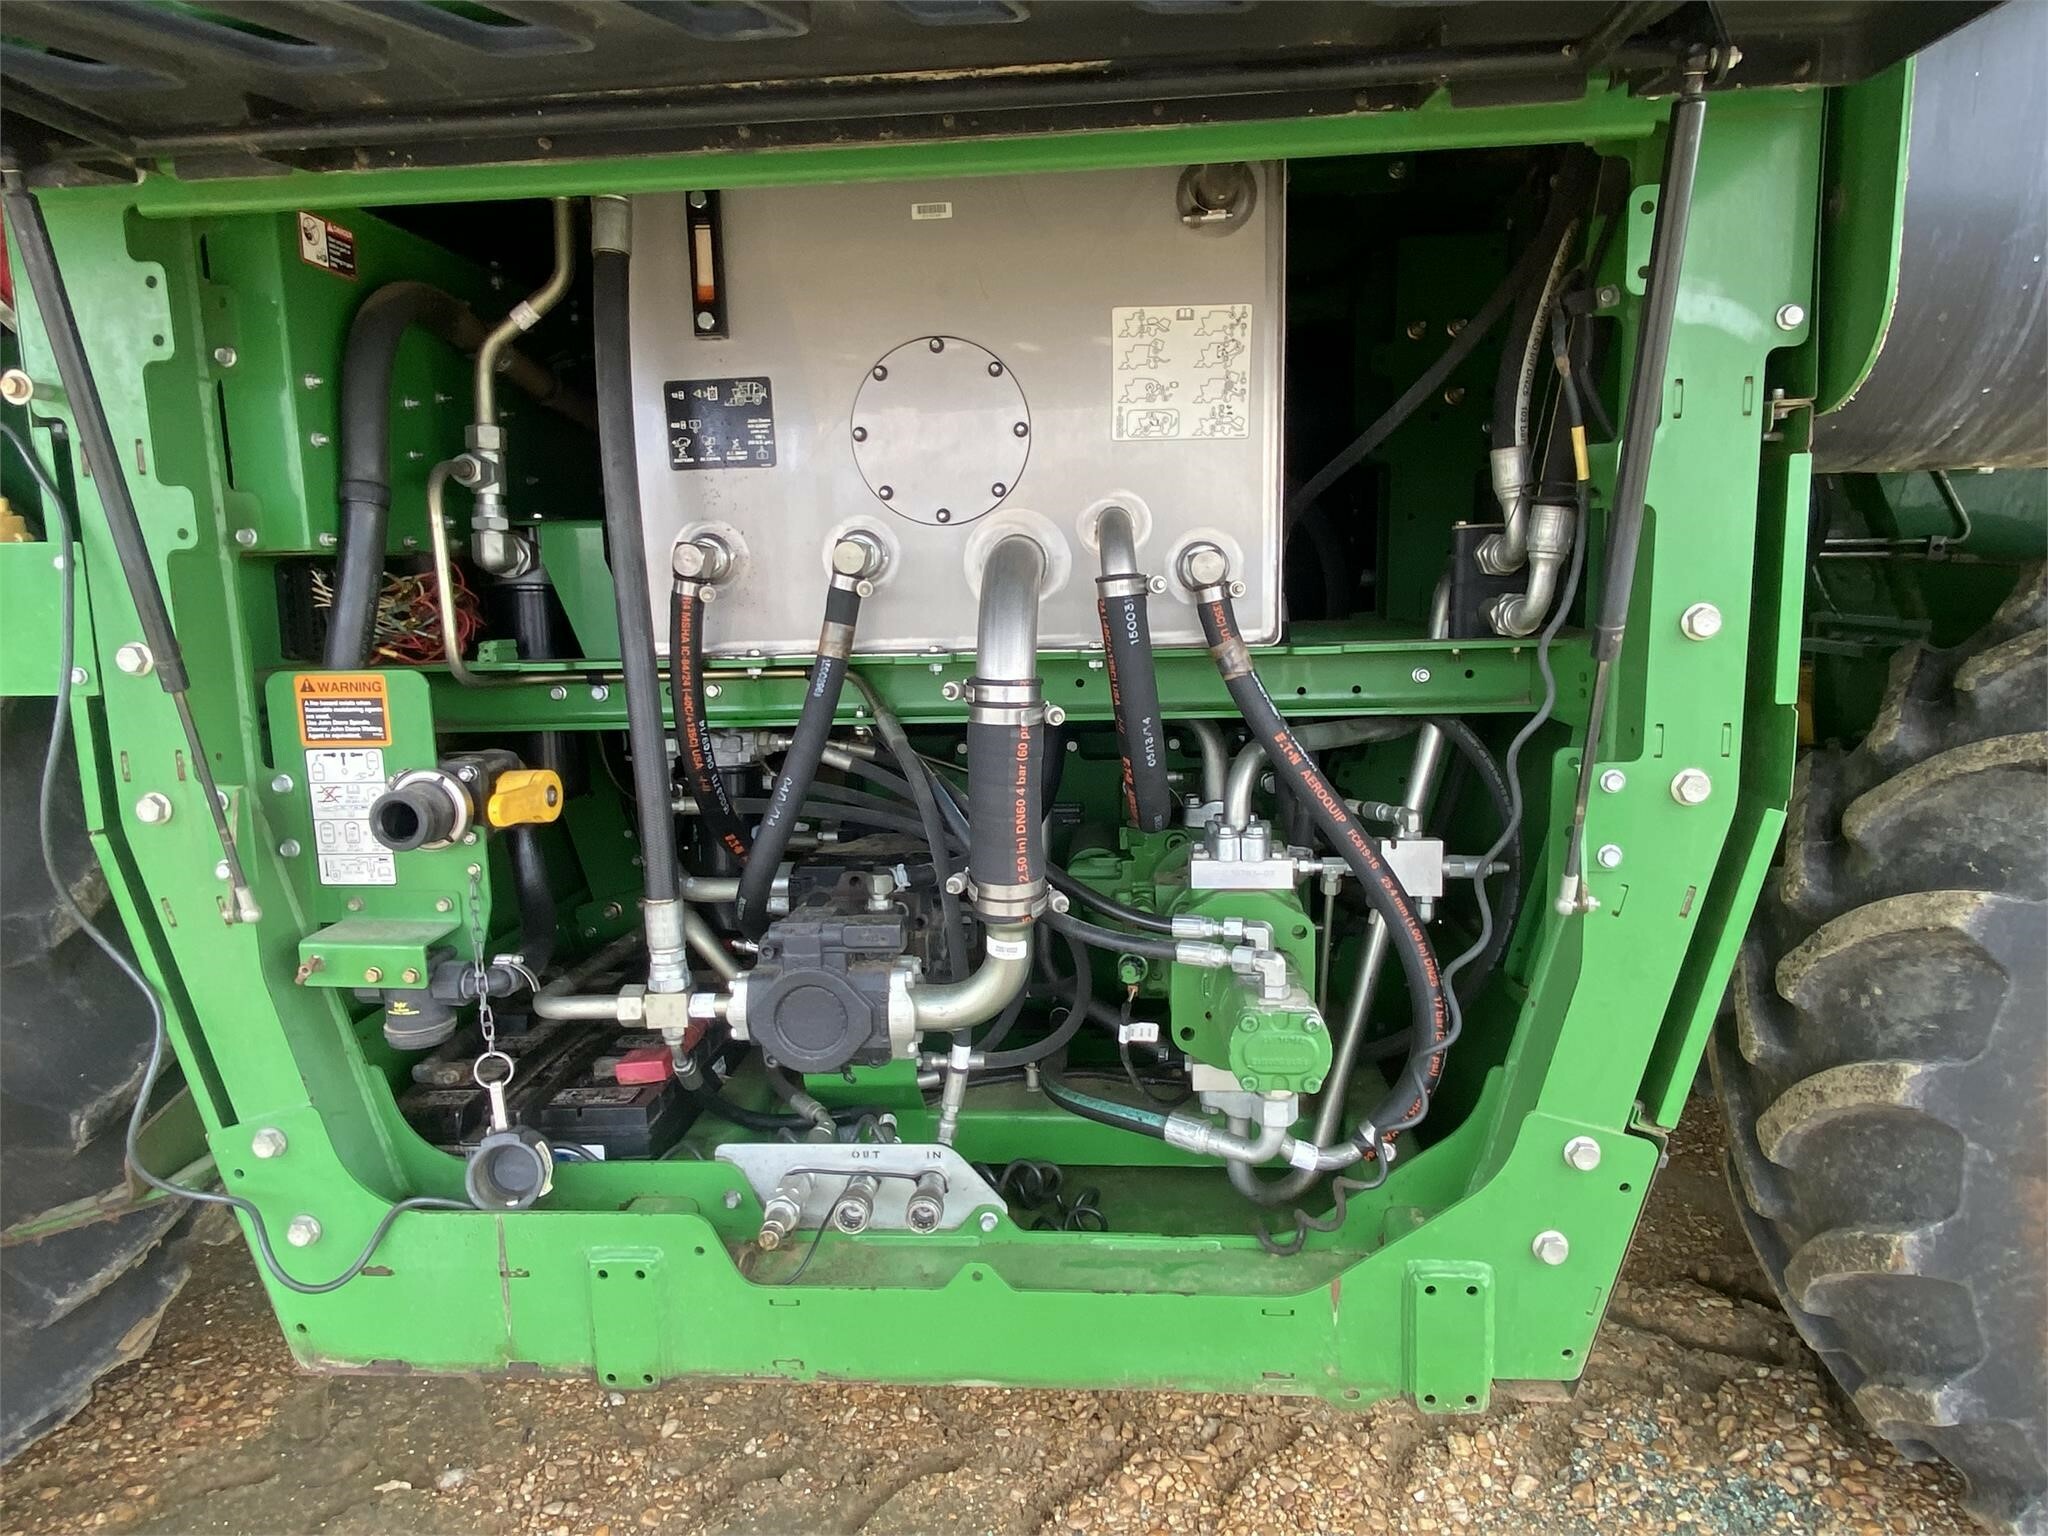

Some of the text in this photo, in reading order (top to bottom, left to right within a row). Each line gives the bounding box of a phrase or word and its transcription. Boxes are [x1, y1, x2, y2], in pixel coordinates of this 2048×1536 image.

[316, 681, 382, 693] WARNING
[681, 612, 691, 643] MSHA
[691, 748, 705, 771] USA
[1016, 740, 1029, 762] (60
[1016, 765, 1027, 784] bar
[1016, 788, 1026, 796] 4
[1015, 798, 1027, 834] DN60
[1017, 836, 1029, 855] in)
[1018, 857, 1030, 883] 2.50
[1300, 768, 1348, 824] AEROQUIP
[1346, 828, 1381, 871] FC619-16
[1394, 896, 1409, 917] mm
[1434, 1009, 1444, 1028] bar
[851, 1150, 881, 1159] OUT
[926, 1151, 942, 1159] IN
